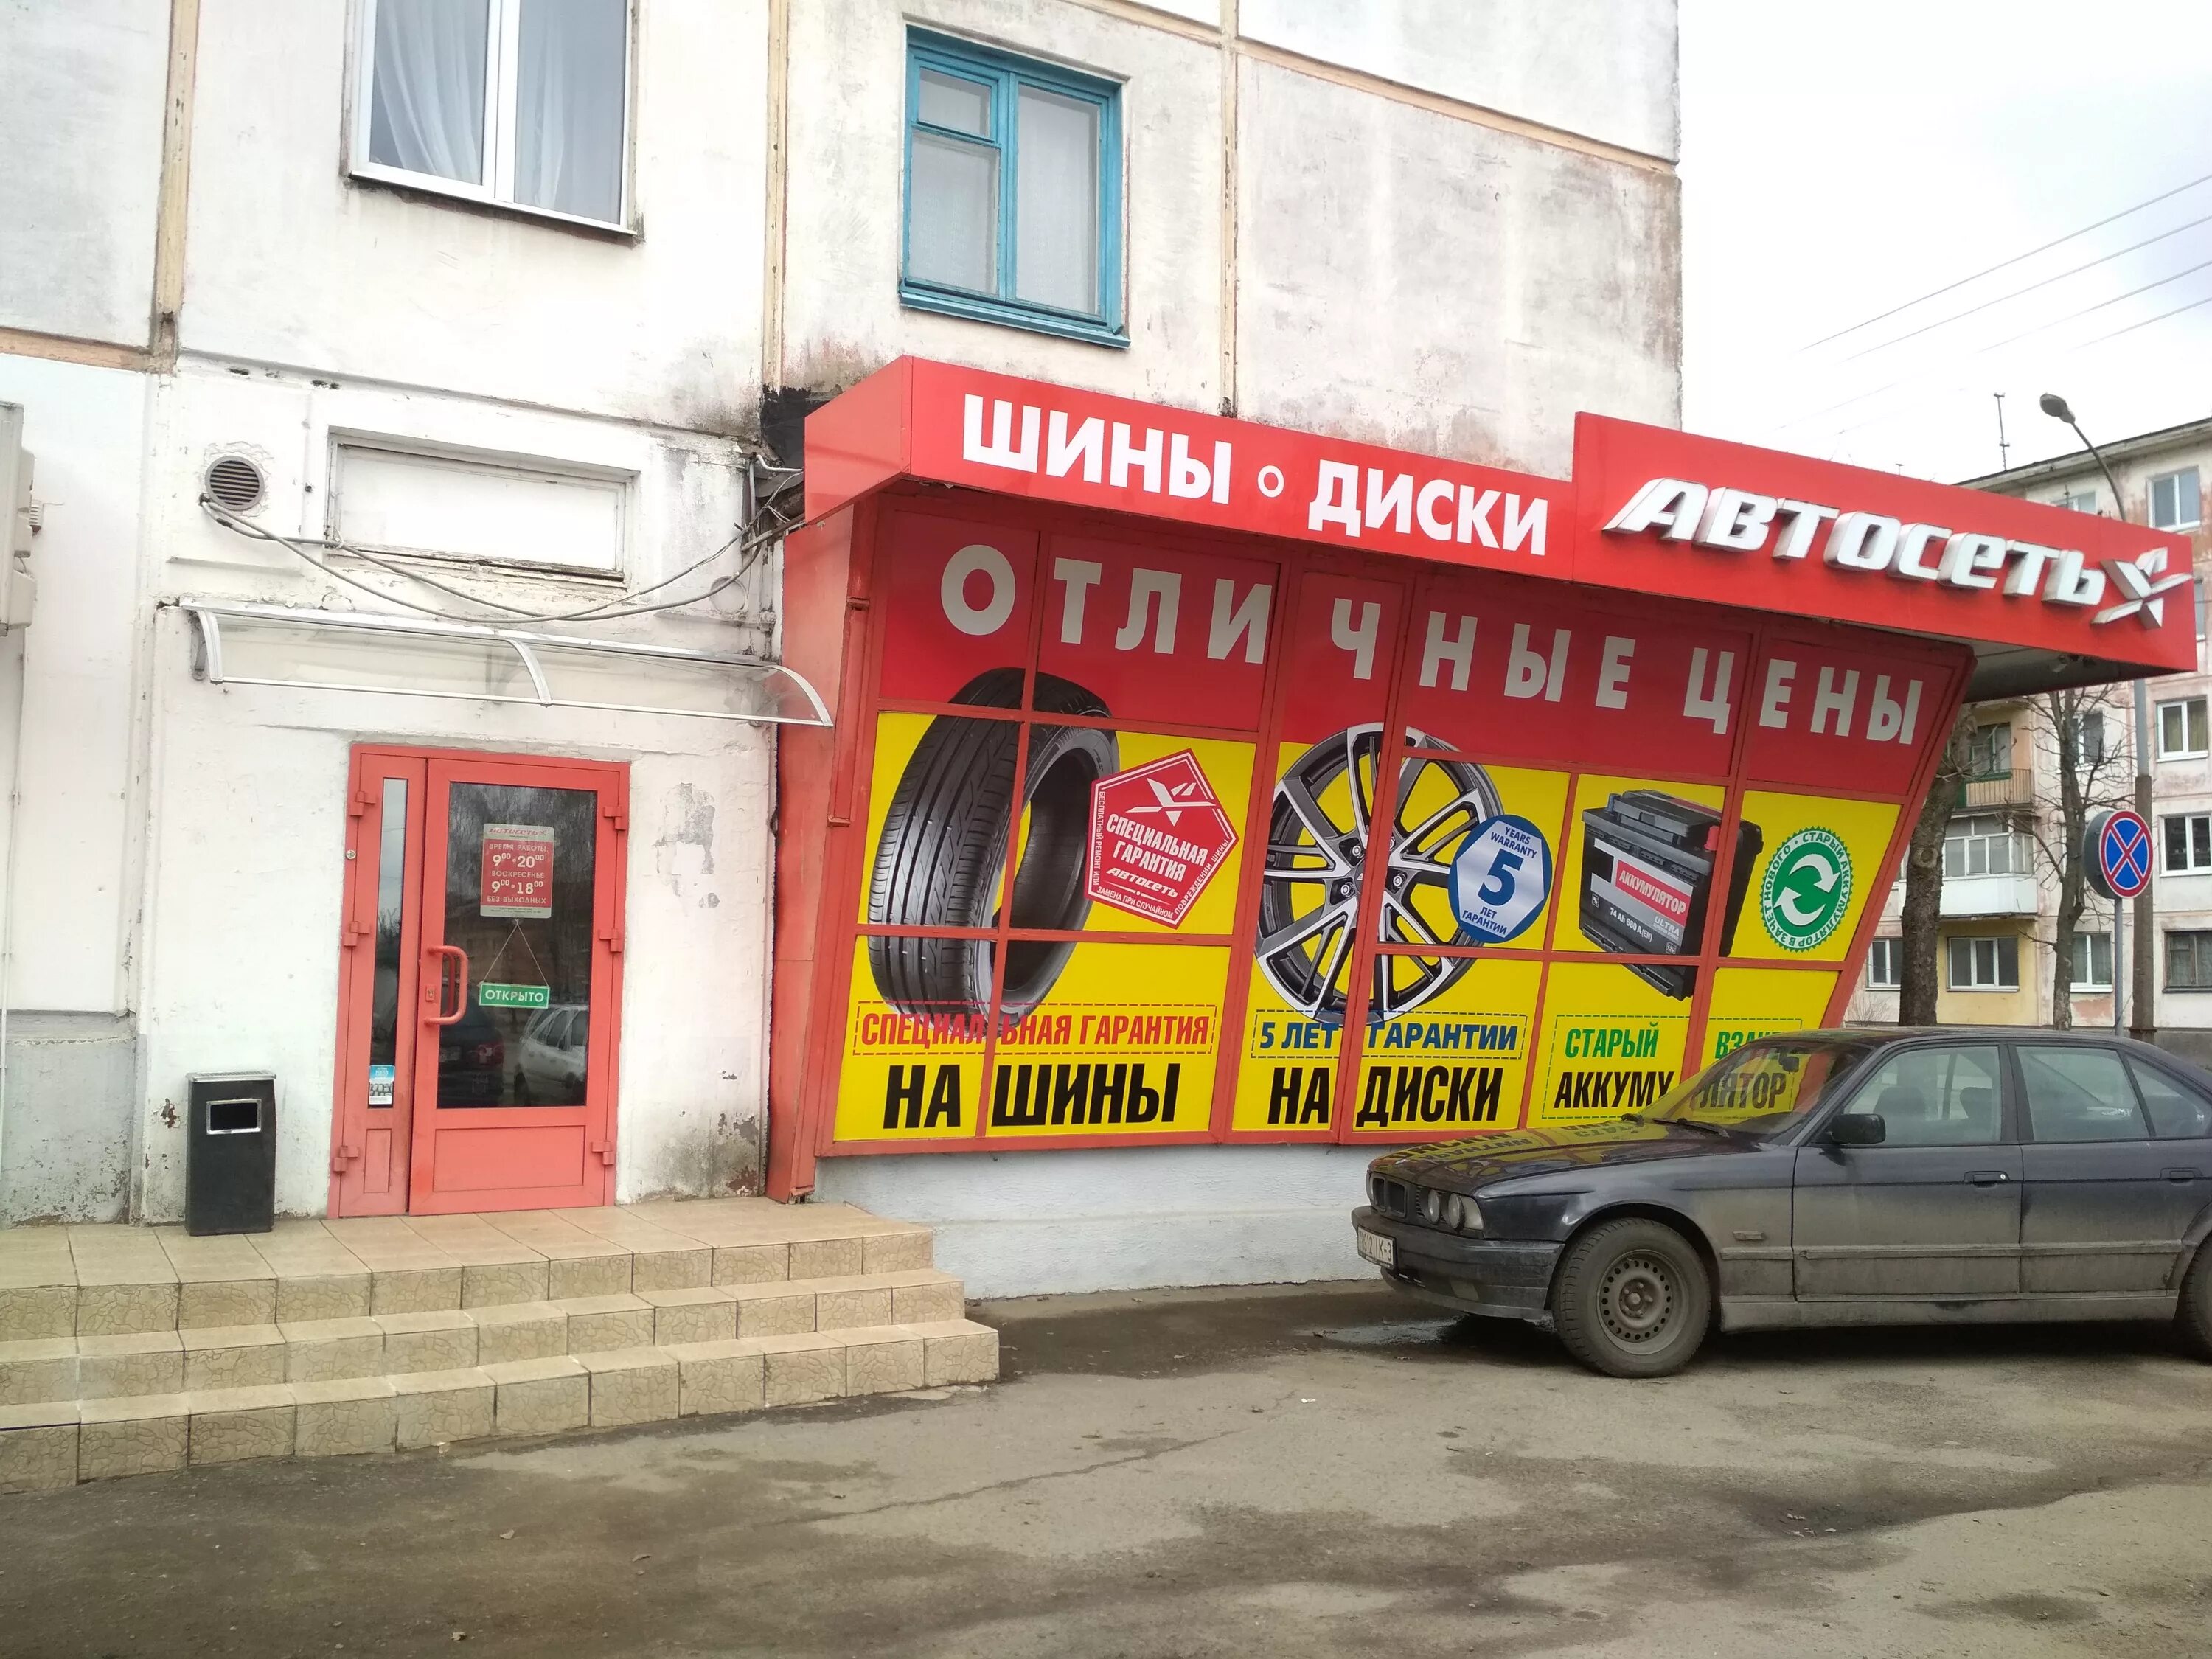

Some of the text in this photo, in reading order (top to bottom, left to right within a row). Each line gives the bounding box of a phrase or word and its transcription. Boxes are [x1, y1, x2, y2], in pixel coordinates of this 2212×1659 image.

[962, 393, 1549, 557] ШИНЫ ДИСКИ
[1683, 647, 1923, 745] ЦЕНЫ
[1096, 791, 1106, 840] БЕСПЛАТНЫЙ
[518, 844, 546, 852] РАБОТЫ
[1106, 813, 1208, 867] СПЕЦИАЛЬНАЯ
[1490, 832, 1537, 858] WARRANTY
[1505, 827, 1531, 845] YEARS
[1802, 832, 1844, 859] СТАРЫЙ
[1093, 841, 1102, 869] РЕМОНТ
[1113, 841, 1187, 882] ГАРАНТИЯ
[1175, 838, 1229, 915] ПОВРЕЖДЕНИИ ШИНЫ
[1478, 848, 1524, 906] 5
[1764, 845, 1791, 901] НОВОГО
[1097, 886, 1173, 919] ЗАМЕНА ПРИ СЛУЧАЙНОМ
[1618, 869, 1686, 914] АККУМУЛЯТОР
[1798, 861, 1850, 947] АККУМУЛЯТОР
[1462, 910, 1507, 935] ГАРАНТИИ
[1480, 906, 1497, 919] ЛЕТ
[1610, 907, 1617, 918] 74
[1617, 912, 1625, 924] Ah
[1655, 916, 1680, 936] ULTRA
[1789, 937, 1795, 946] В
[485, 990, 544, 1002] ОТКРЫТО
[861, 1013, 1210, 1048] СПЕЦИАЛЬНАЯ ГАРАНТИЯ
[1259, 1021, 1518, 1051] 5 ЛЕТ ГАРАНТИИ
[1565, 1022, 1660, 1058] СТАРЫЙ
[883, 1063, 1181, 1129] НА ШИНЫ
[1267, 1065, 1504, 1127] НА ДИСКИ
